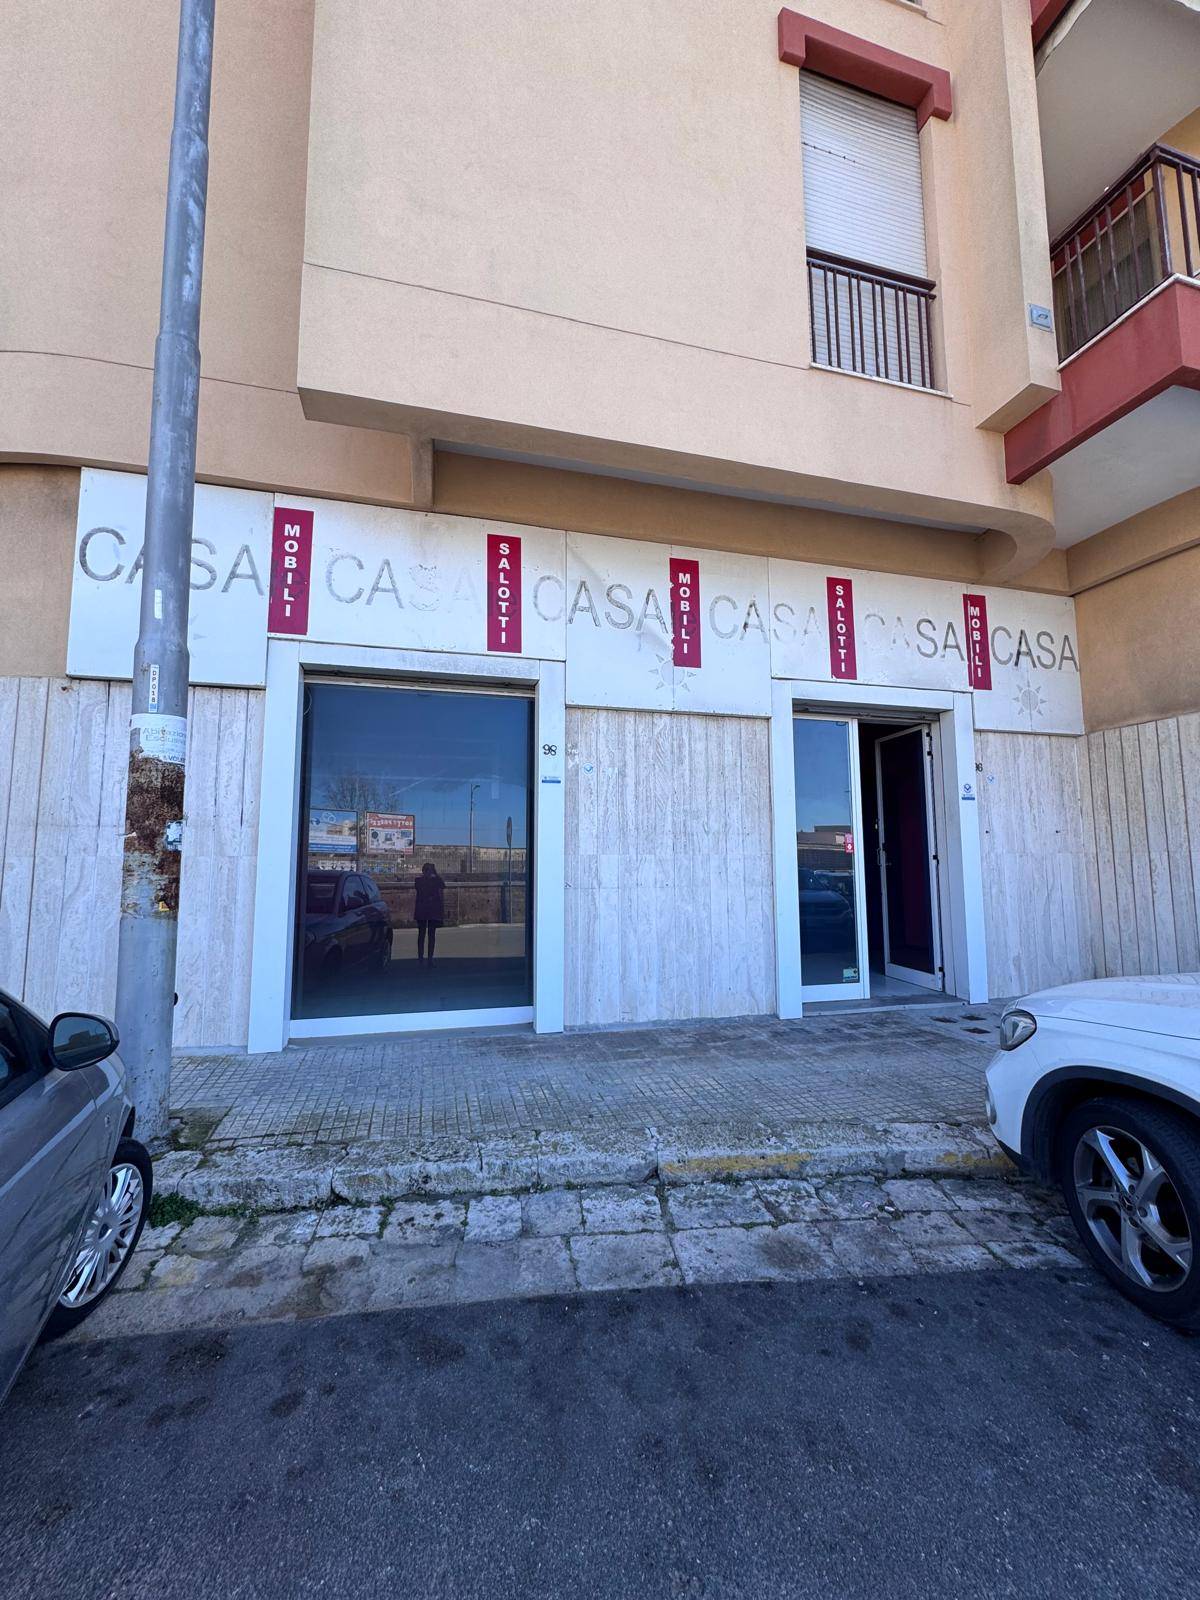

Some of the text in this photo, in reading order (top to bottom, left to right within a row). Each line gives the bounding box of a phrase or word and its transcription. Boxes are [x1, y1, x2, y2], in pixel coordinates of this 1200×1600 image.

[283, 523, 301, 617] MOBILI
[497, 543, 511, 644] SALOTTI
[533, 575, 668, 634] CASA
[678, 572, 692, 654] MOBILI
[709, 594, 824, 645] CASA
[835, 585, 848, 673] SALOTTI
[970, 606, 983, 678] MOBILI
[991, 626, 1079, 672] CASA
[542, 743, 558, 756] 98
